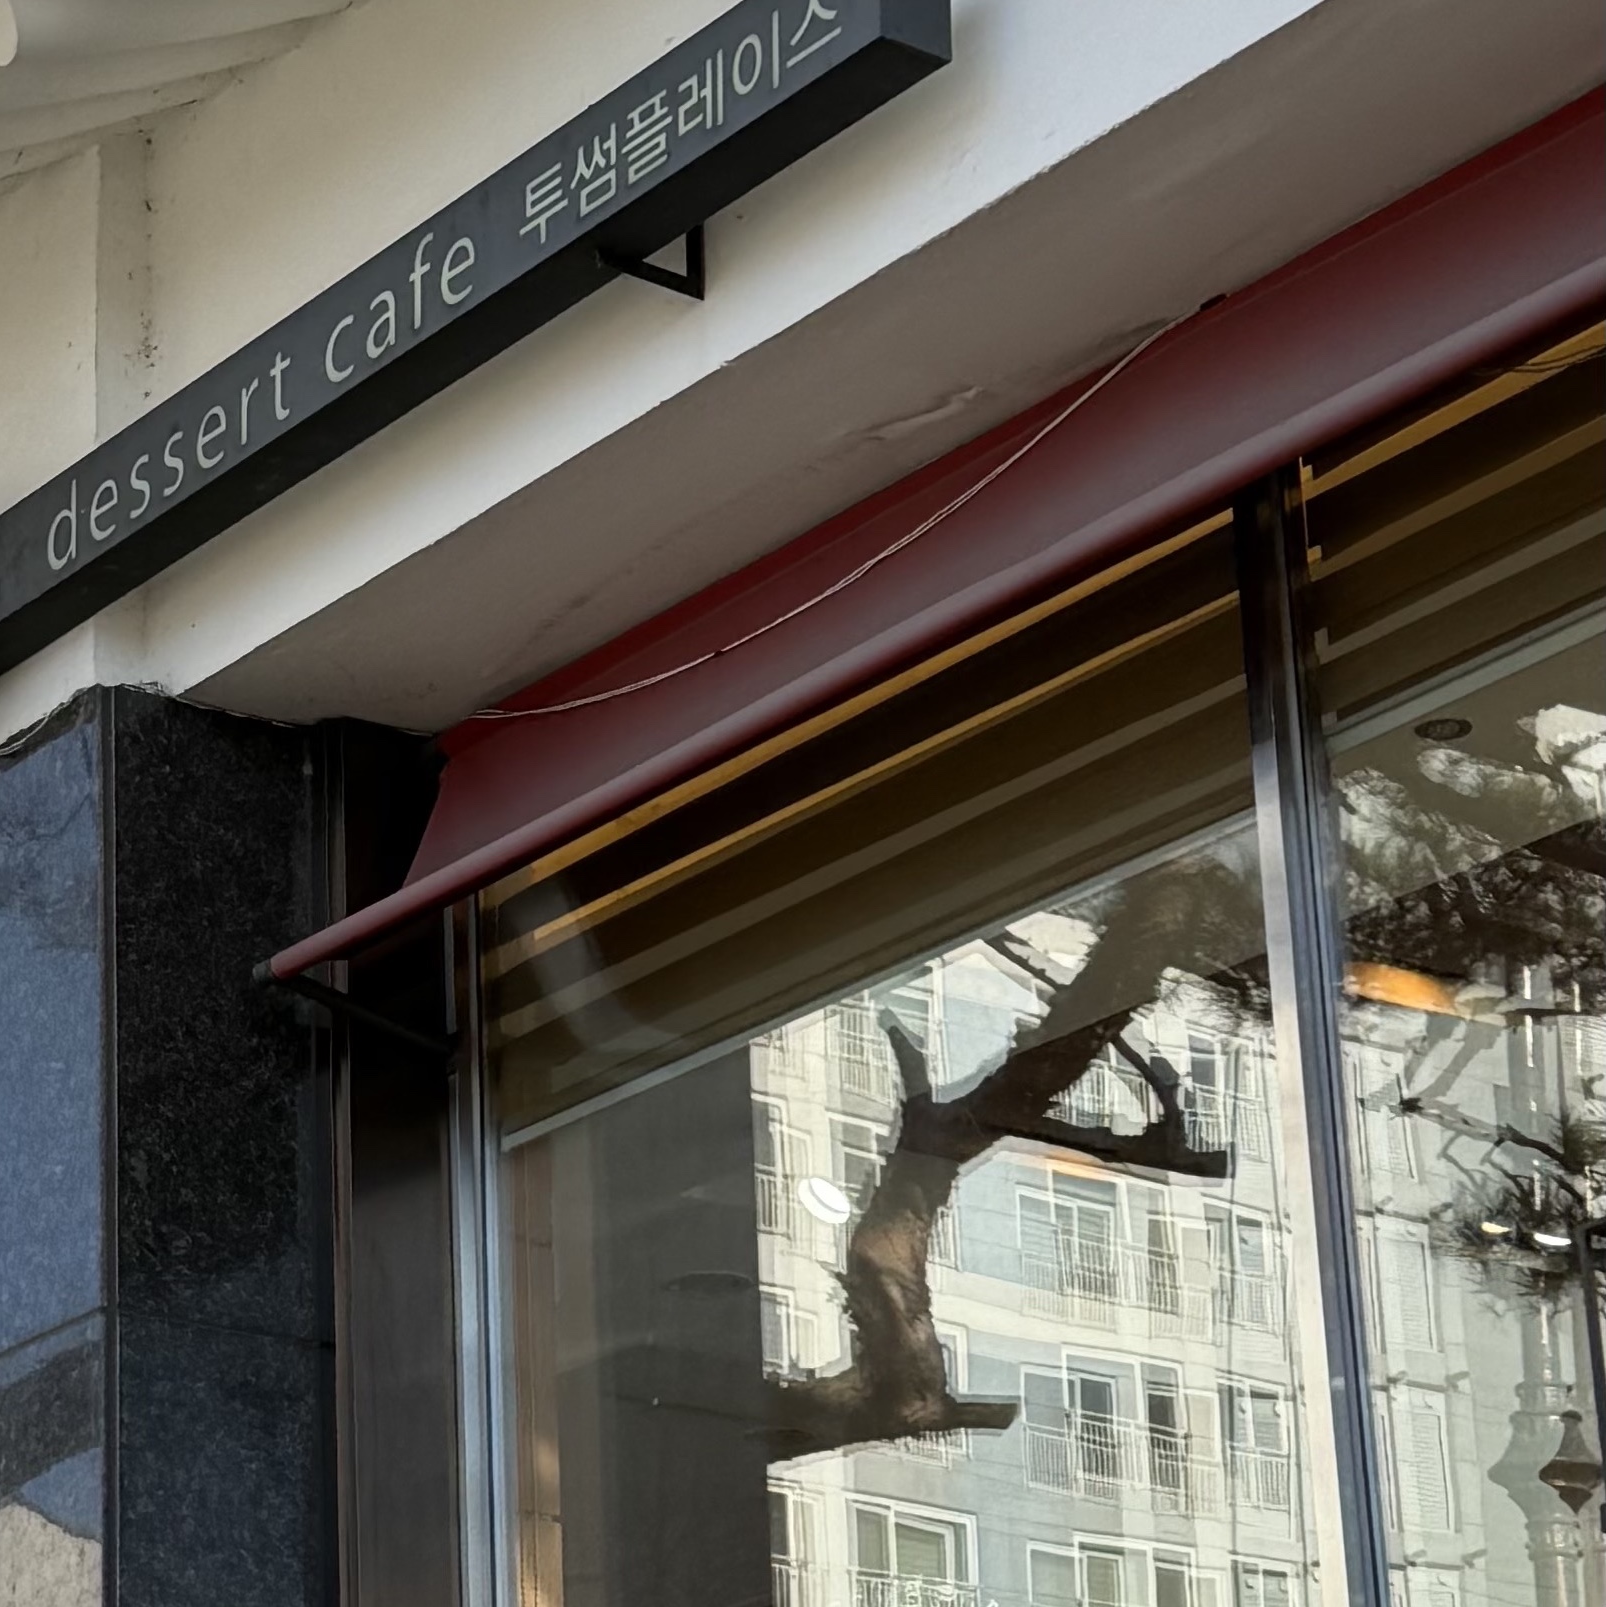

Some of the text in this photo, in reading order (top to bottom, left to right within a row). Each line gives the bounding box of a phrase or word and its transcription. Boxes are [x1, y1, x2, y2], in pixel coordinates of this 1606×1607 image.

[519, 0, 842, 243] 투썸플레이스
[47, 232, 476, 571] dessert cafe
